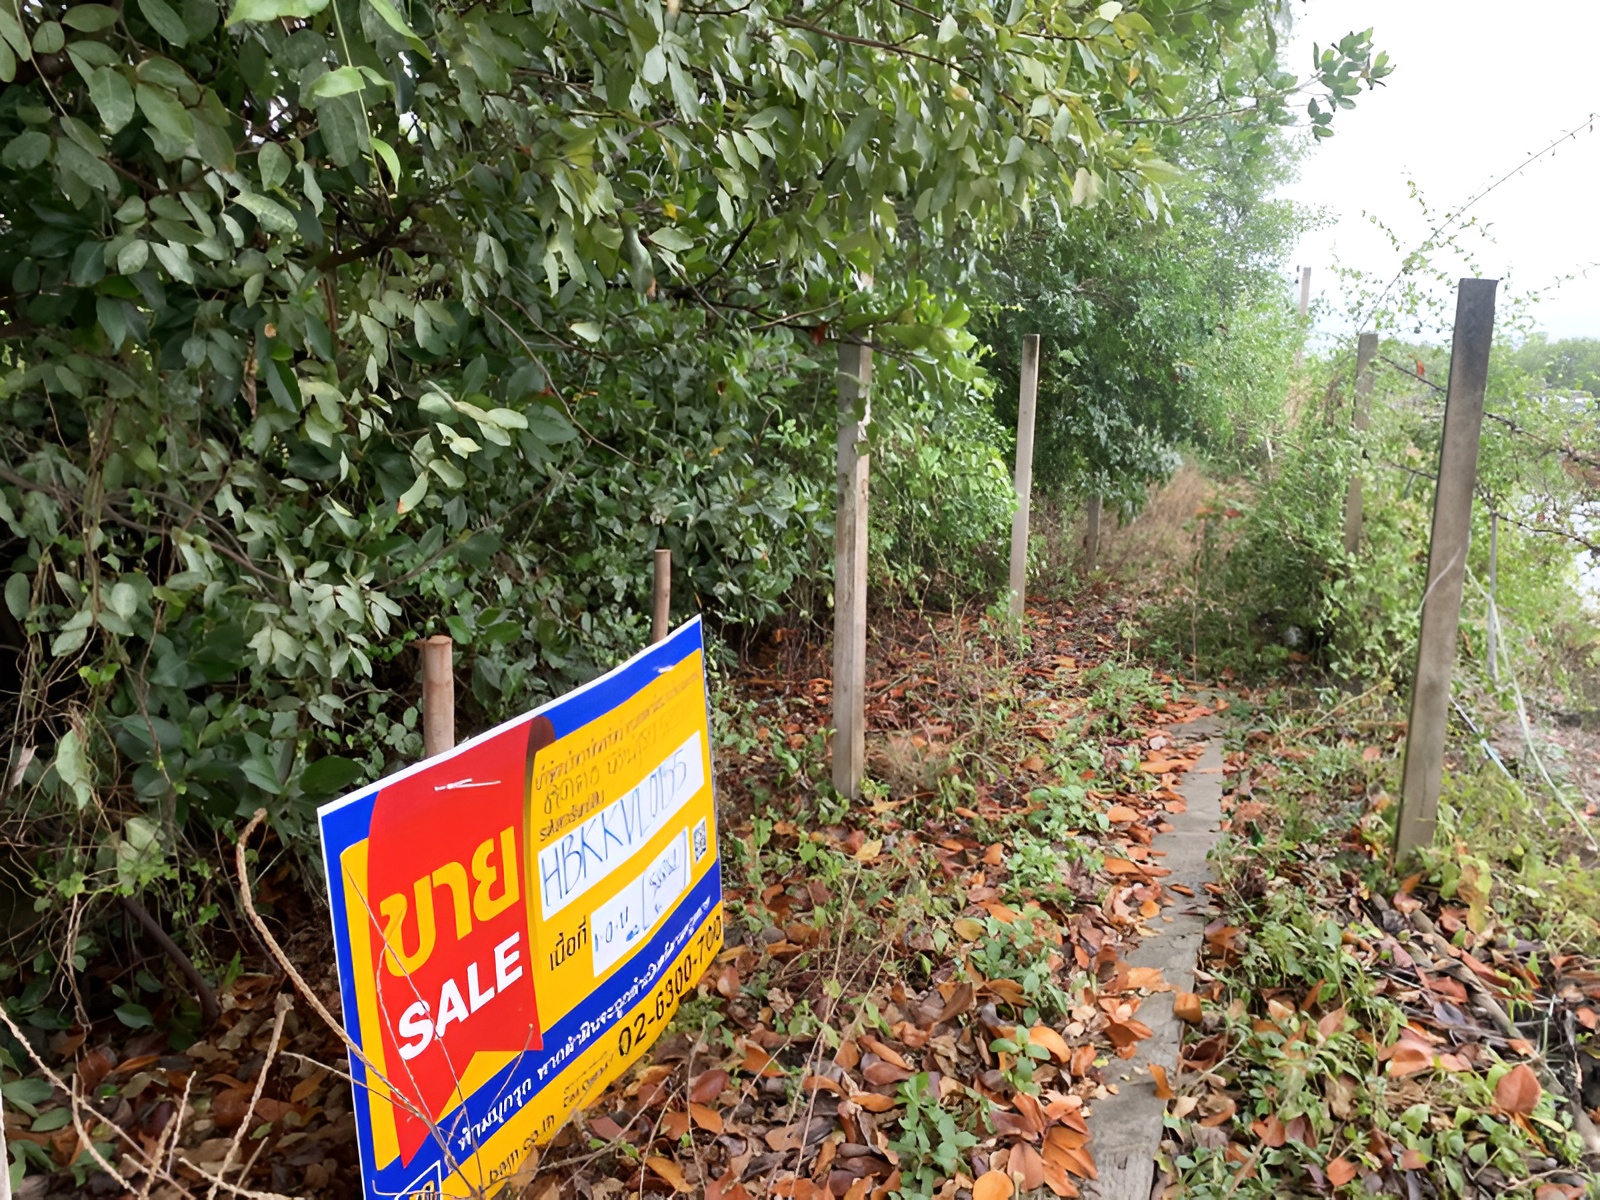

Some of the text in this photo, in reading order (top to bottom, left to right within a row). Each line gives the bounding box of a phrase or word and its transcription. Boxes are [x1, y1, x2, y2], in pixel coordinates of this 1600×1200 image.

[379, 825, 521, 978] ขาย
[549, 914, 588, 971] เนื้อที่
[397, 932, 524, 1062] SALE
[457, 1077, 532, 1151] ห้ามบุกรุก
